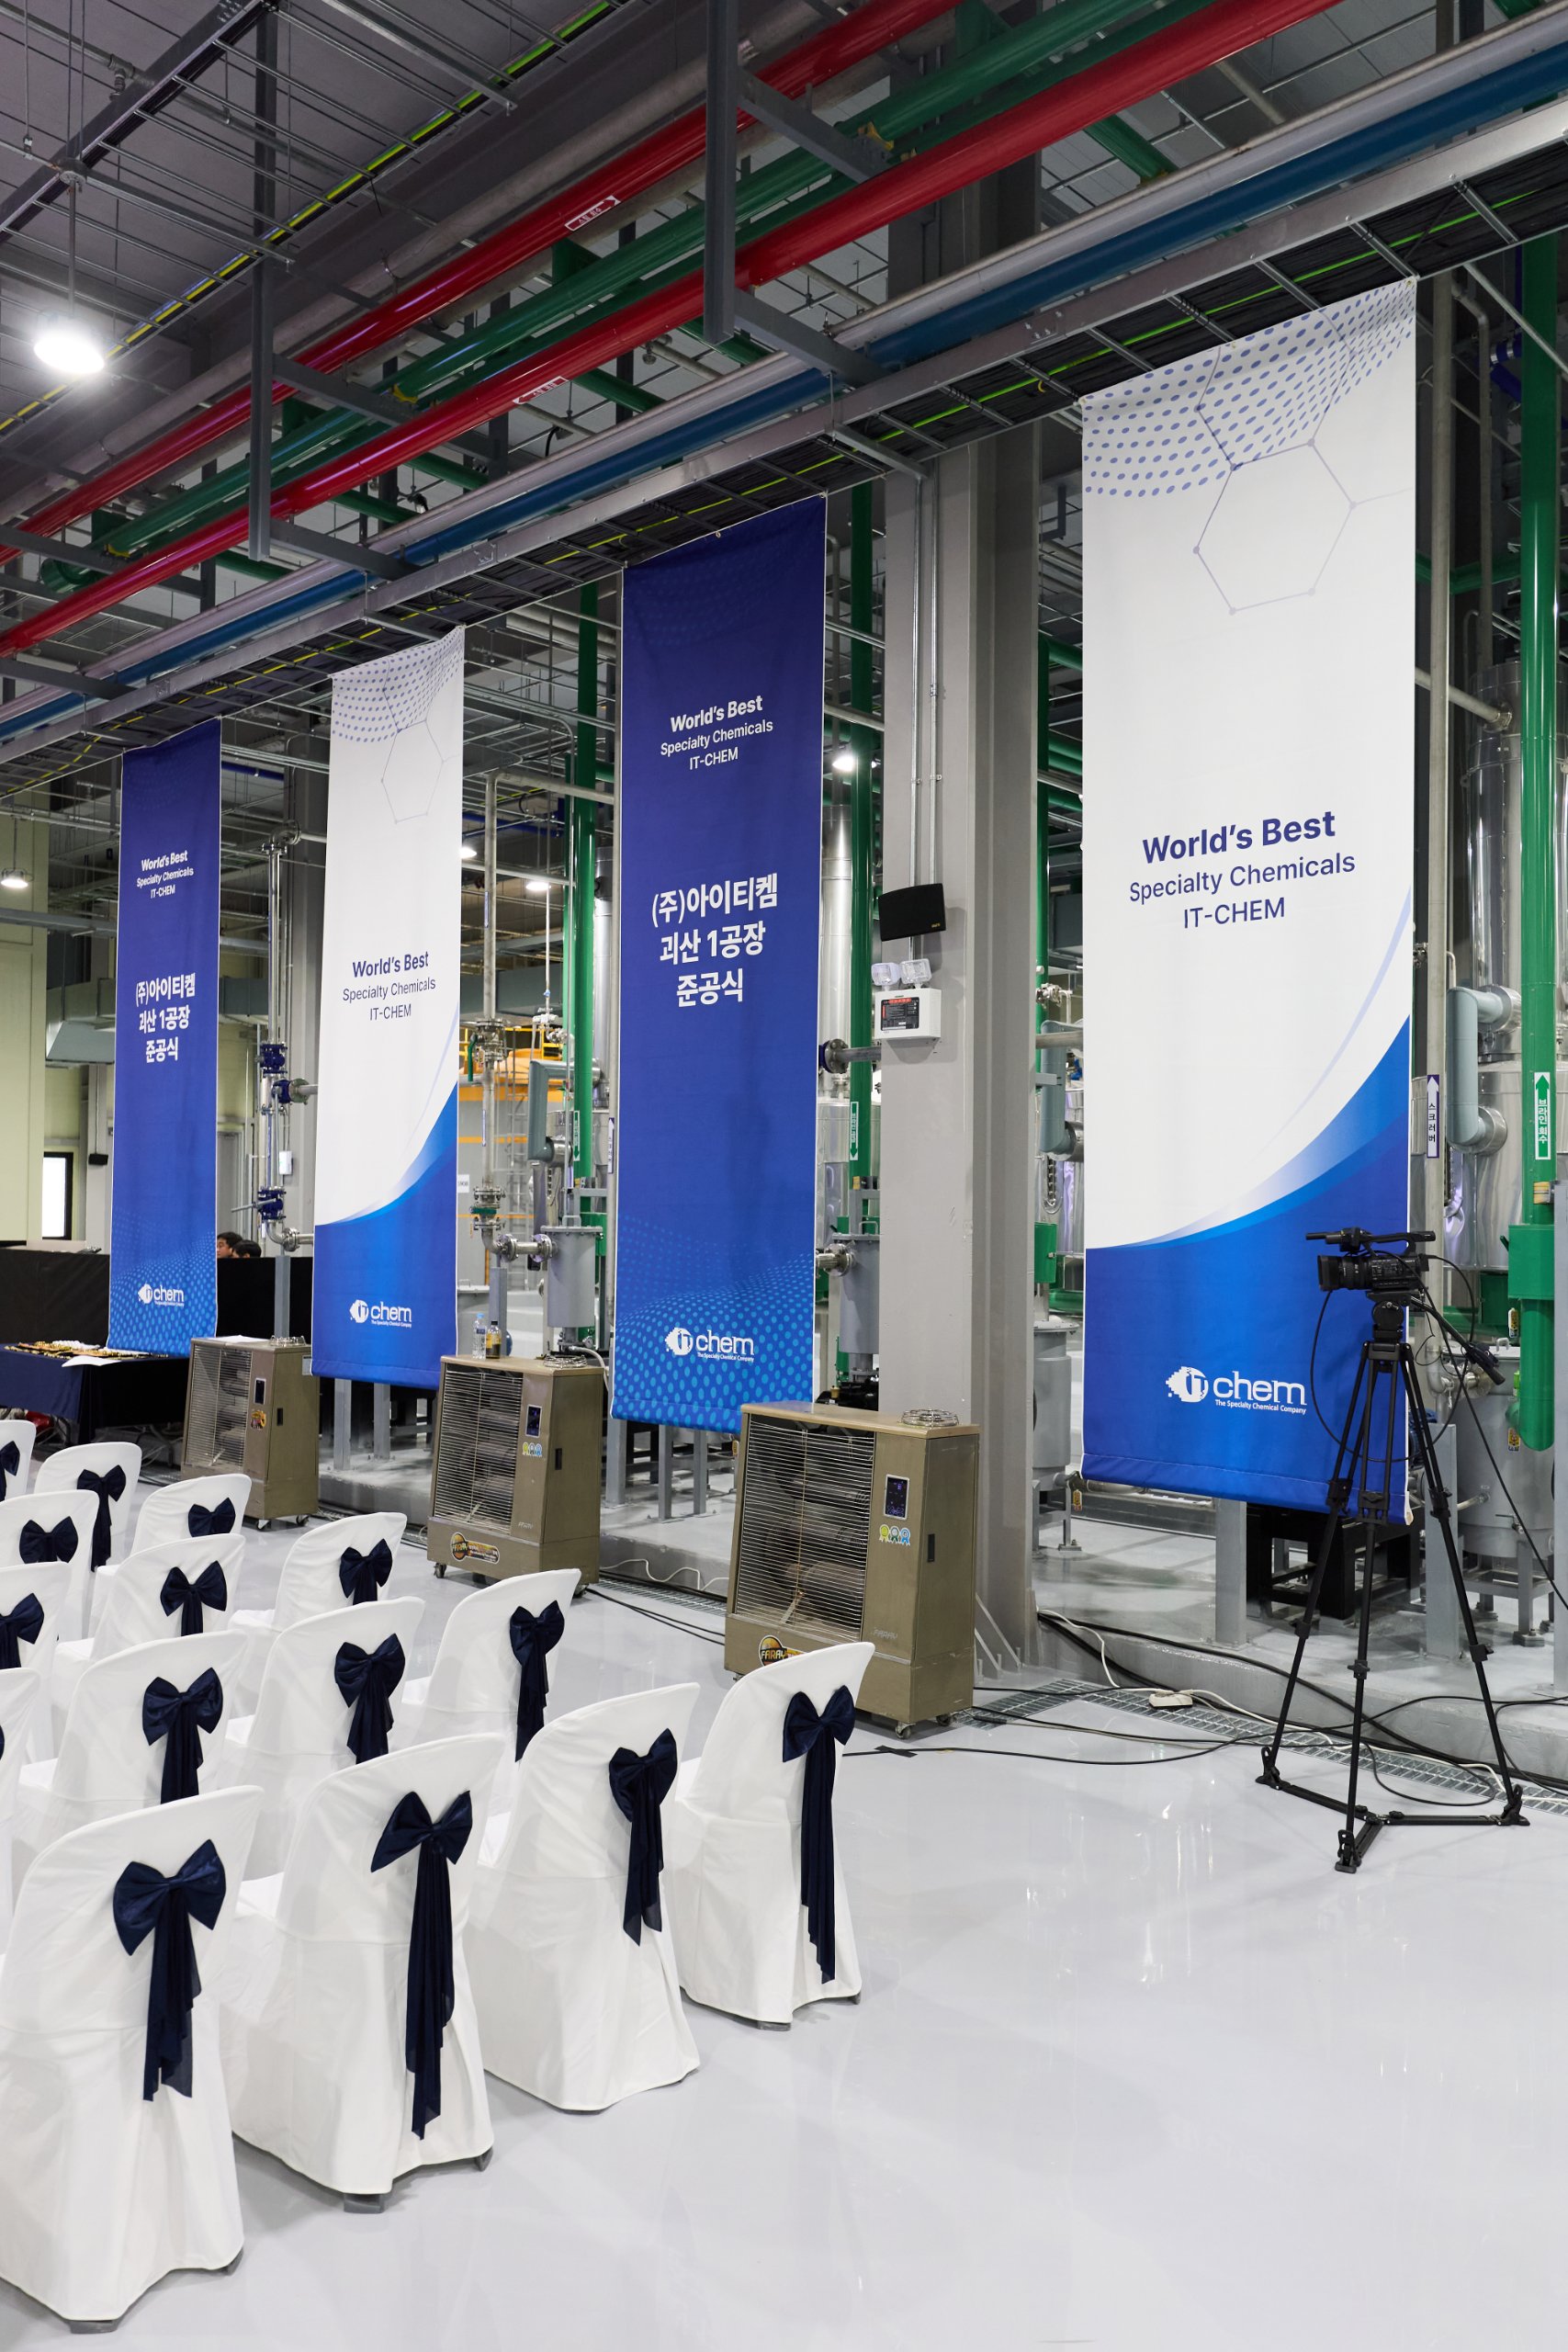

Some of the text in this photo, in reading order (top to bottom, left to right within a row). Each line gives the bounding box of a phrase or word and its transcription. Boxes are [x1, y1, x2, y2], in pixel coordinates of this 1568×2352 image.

[670, 695, 764, 733] World's Best
[660, 719, 773, 758] Specialty Chemicals
[688, 746, 739, 772] IT-CHEM
[1143, 811, 1337, 865] World's Best
[141, 850, 188, 872] World's Best
[136, 866, 195, 889] Specialty Chemicals
[151, 884, 175, 899] IT-CHEM
[1130, 852, 1357, 905] Specialty Chemicals
[651, 872, 779, 929] (주)아이티켐
[1184, 897, 1286, 929] IT-CHEM
[660, 920, 766, 966] 괴산 1공장
[352, 951, 429, 978] World's Best
[135, 972, 196, 1008] (주)아이티켐
[343, 977, 437, 1004] Specialty Chemicals
[676, 967, 744, 1008] 준공식
[139, 1004, 191, 1035] 괴산 1공장
[369, 1003, 412, 1021] IT-CHEM
[145, 1035, 179, 1064] 준공식
[1427, 1102, 1437, 1143] 스크러버
[1538, 1099, 1549, 1125] 브라인
[153, 1284, 185, 1303] chem
[370, 1301, 412, 1323] chem
[695, 1329, 755, 1356] chem
[1213, 1370, 1308, 1407] chem
[1214, 1398, 1307, 1416] The Specialty Chemical Company
[761, 1648, 787, 1660] FARAY
